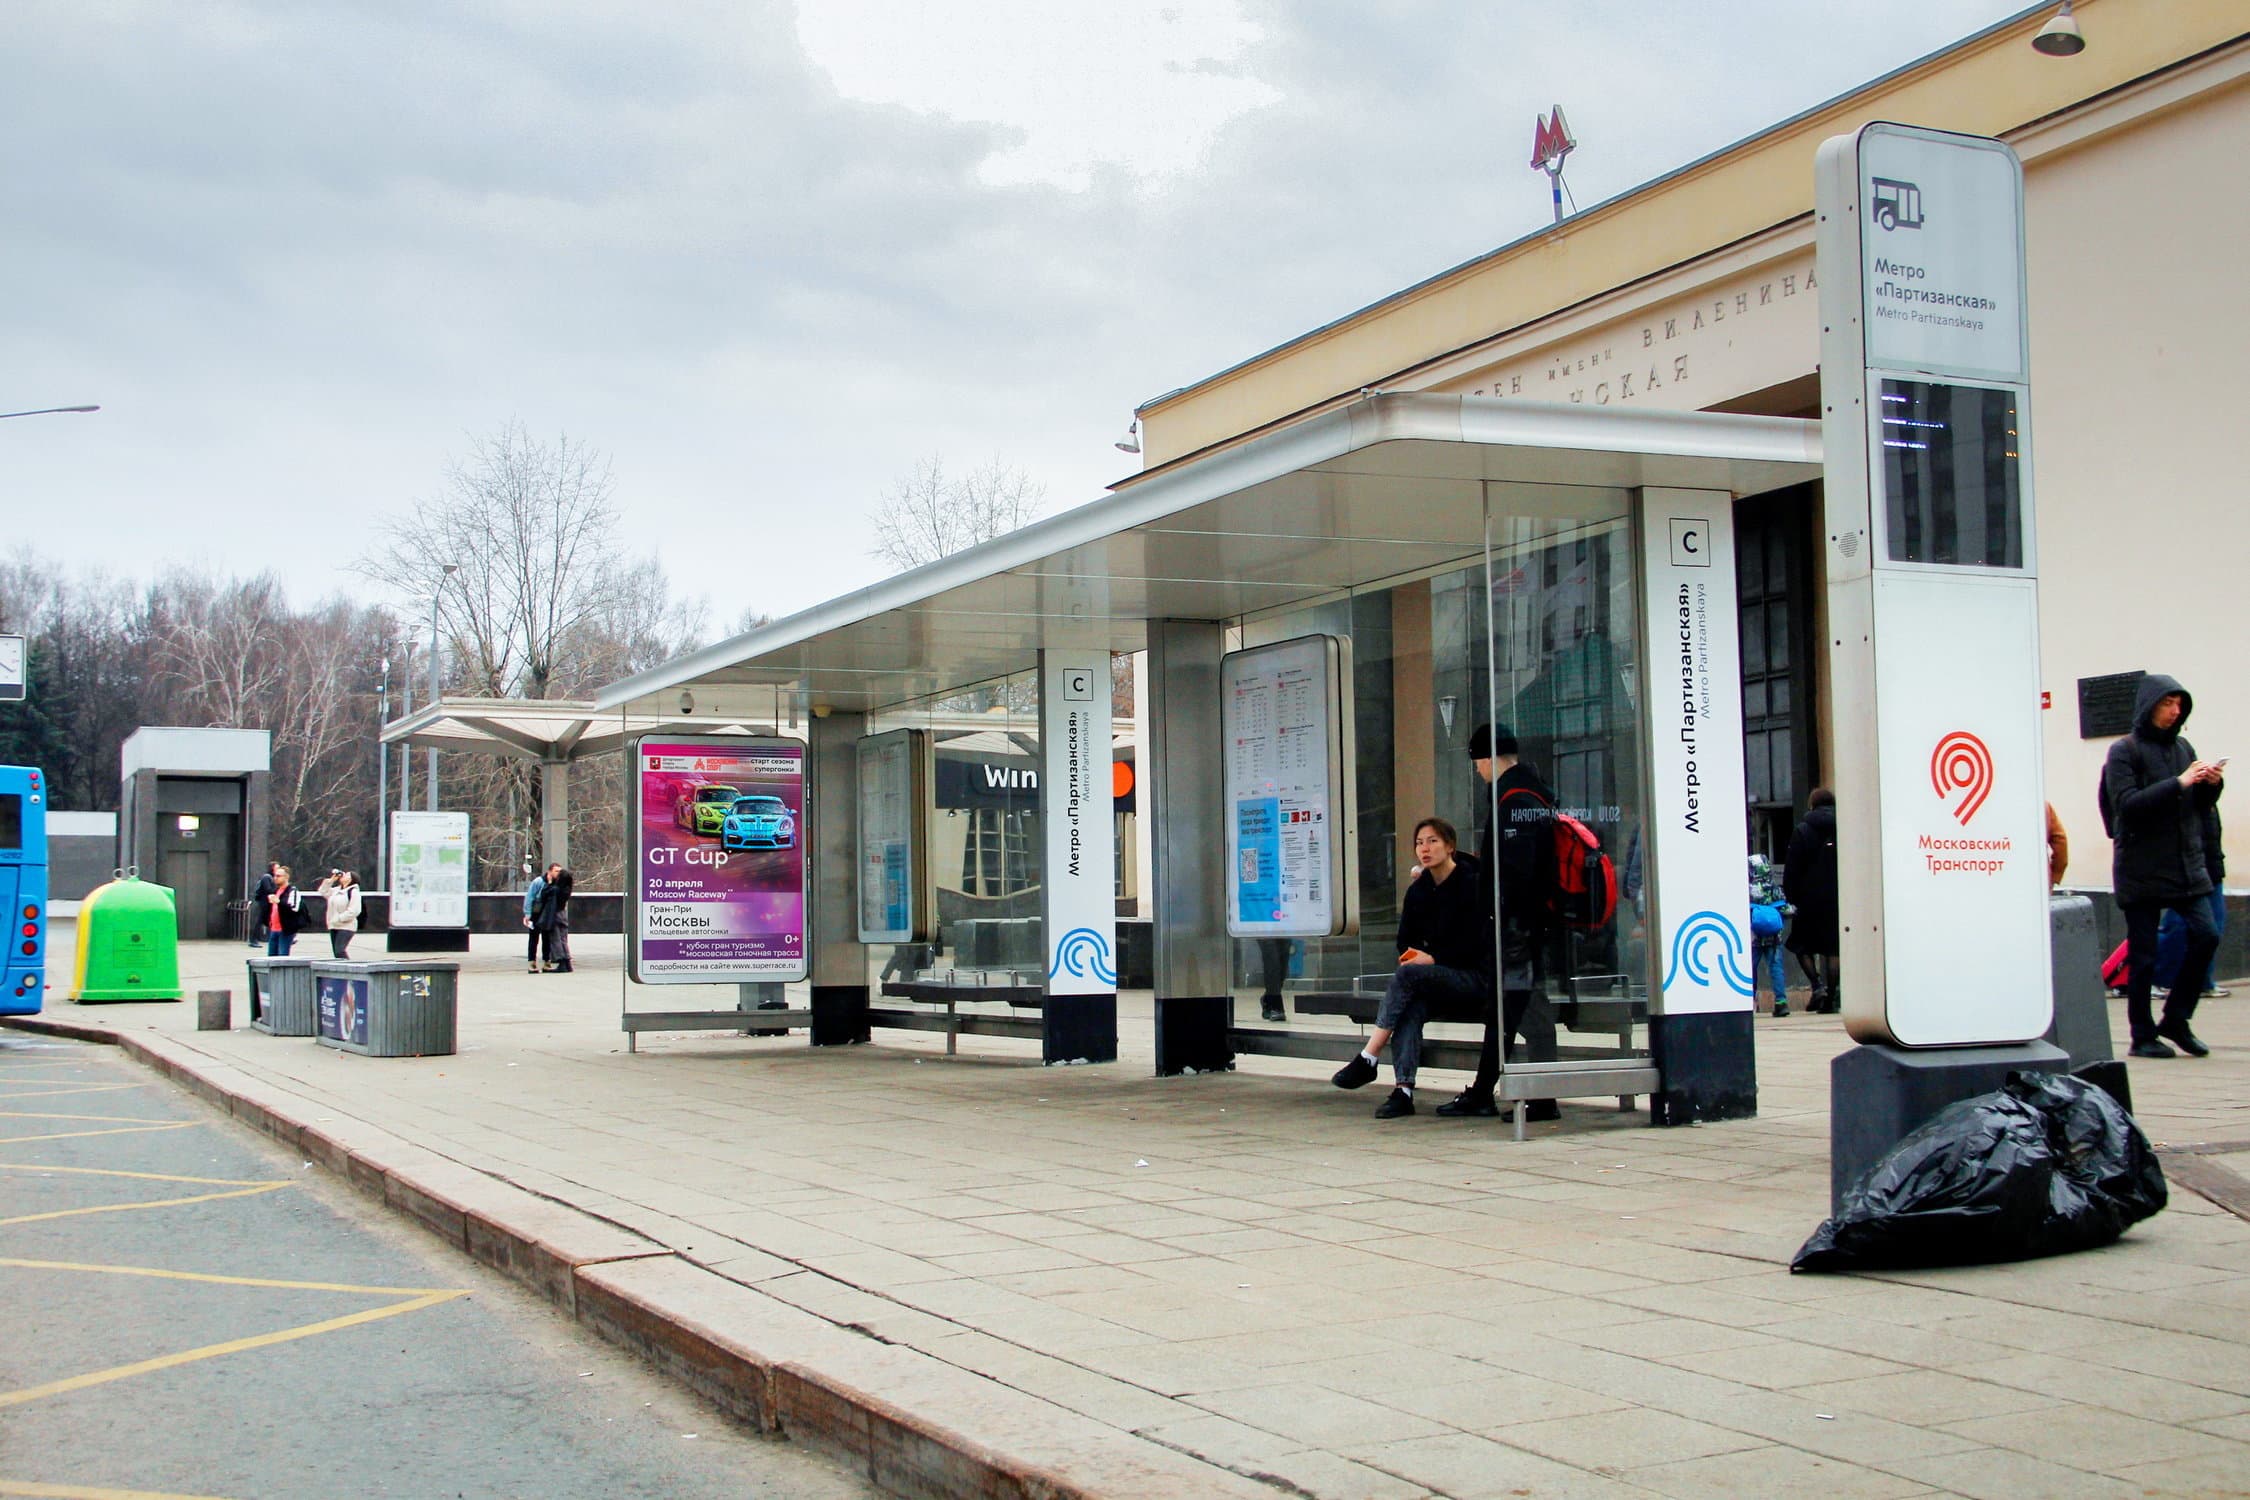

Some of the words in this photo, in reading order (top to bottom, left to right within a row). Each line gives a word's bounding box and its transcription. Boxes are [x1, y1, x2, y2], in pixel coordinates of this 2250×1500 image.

[1875, 257, 1925, 281] Метро
[1693, 268, 1818, 330] ЛЕНИНА
[1876, 281, 1996, 312] «Партизанская»
[1876, 306, 1909, 321] Metro
[1911, 310, 1984, 332] Partizanskaya
[1696, 583, 1709, 673] Partizanskaya
[1678, 583, 1697, 755] «Партизанская»
[1699, 676, 1711, 719] Metro
[1082, 711, 1091, 769] Partizanskaya
[750, 758, 770, 766] старт
[754, 766, 795, 774] супергонки
[1067, 711, 1081, 825] «Партизанская»
[1082, 769, 1090, 801] Metro
[1684, 760, 1700, 834] Метро
[1068, 826, 1081, 877] Метро
[1919, 834, 2011, 850] Московский
[649, 847, 679, 865] GT
[1926, 854, 2004, 876] Транспорт
[649, 879, 663, 888] 20
[665, 881, 704, 889] апреля
[649, 890, 686, 899] Moscow
[650, 905, 692, 914] Гран-При
[650, 915, 710, 927] Москвы
[686, 942, 710, 950] кубок
[784, 934, 800, 944] 0+
[649, 963, 699, 971] подробности
[732, 962, 797, 970] www.superrace.ru
